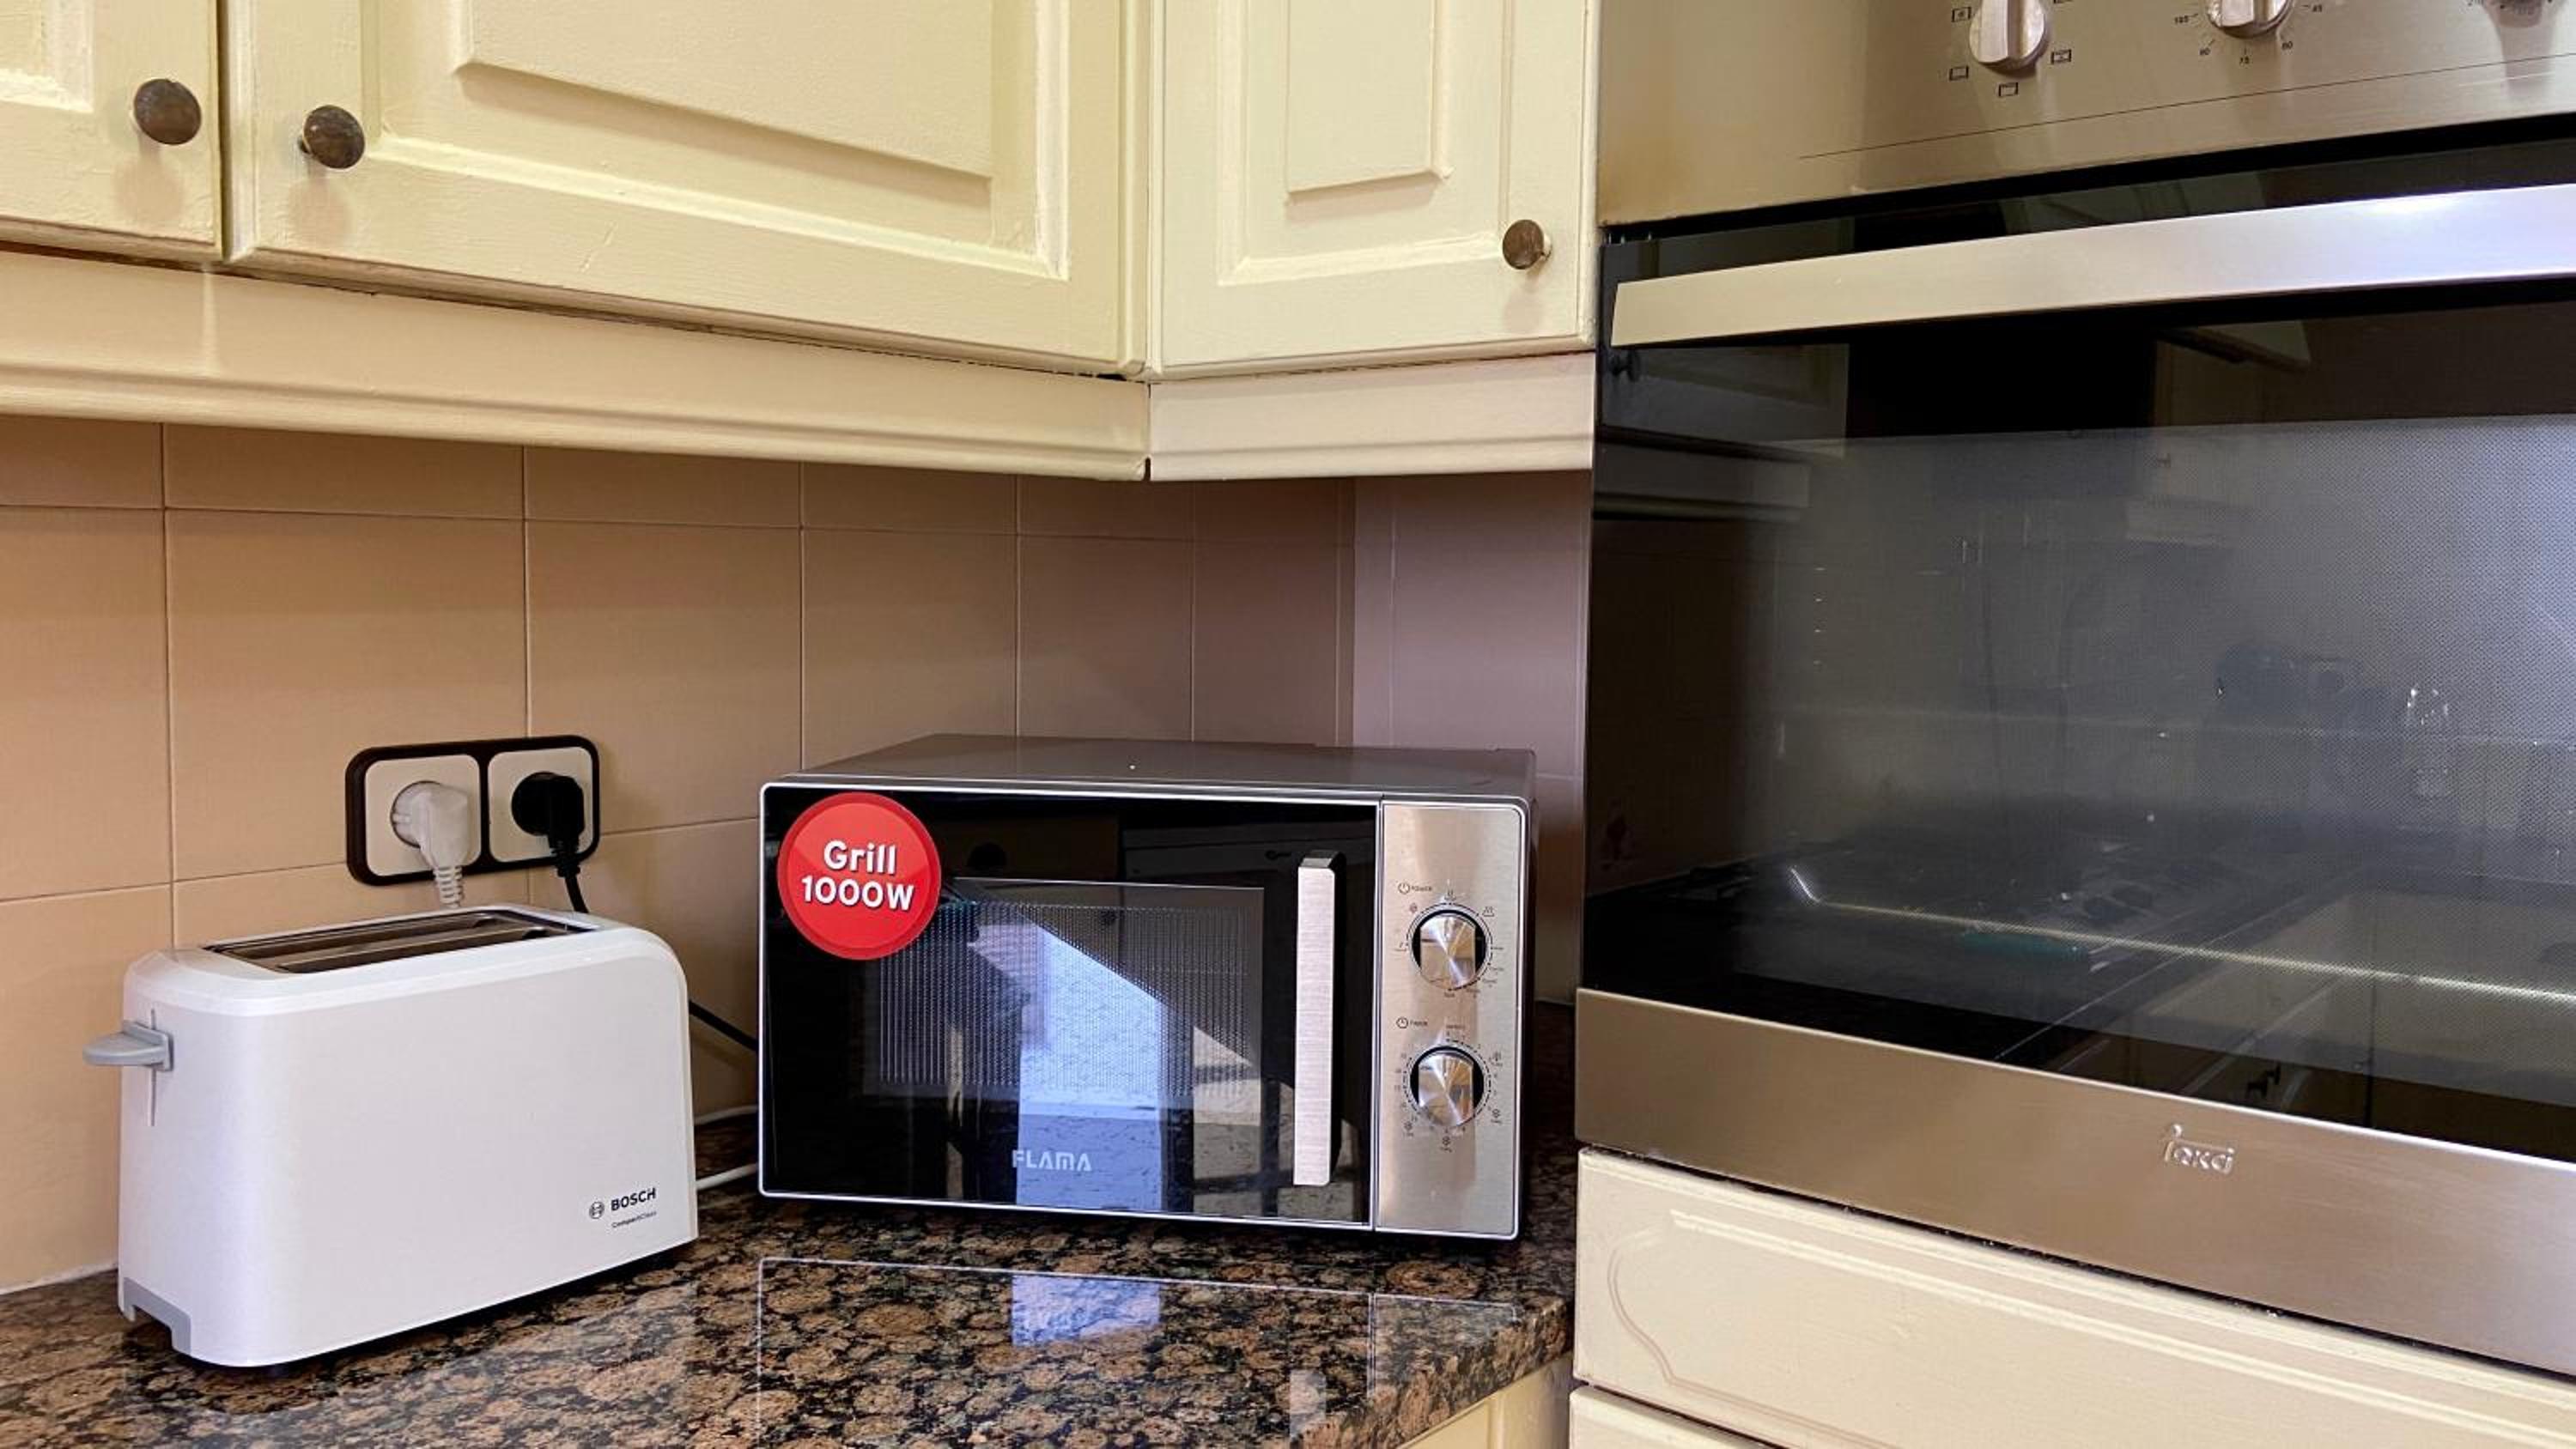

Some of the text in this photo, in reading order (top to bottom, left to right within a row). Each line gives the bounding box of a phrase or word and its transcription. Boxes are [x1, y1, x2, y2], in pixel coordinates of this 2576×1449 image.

[823, 840, 896, 875] Grill
[801, 874, 914, 911] 1000W
[1012, 1149, 1092, 1172] FLAMA
[611, 1187, 656, 1211] BOSCH
